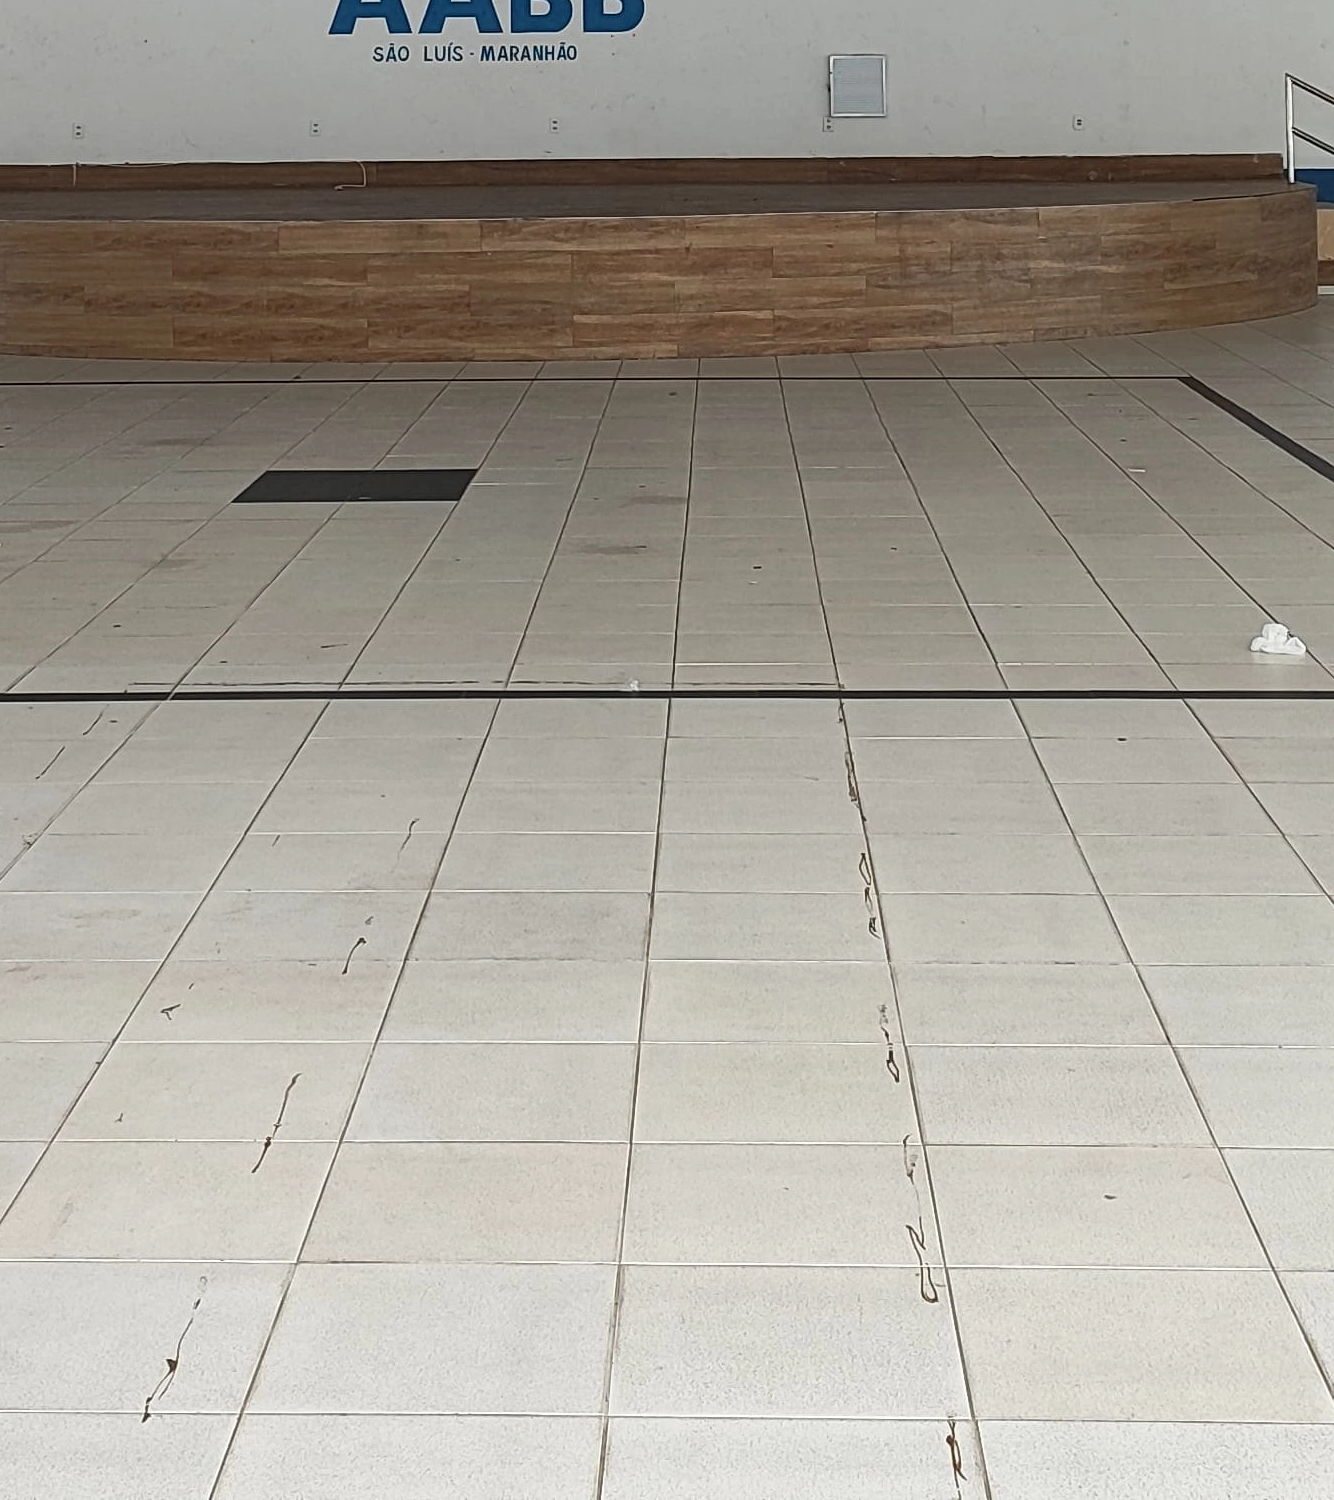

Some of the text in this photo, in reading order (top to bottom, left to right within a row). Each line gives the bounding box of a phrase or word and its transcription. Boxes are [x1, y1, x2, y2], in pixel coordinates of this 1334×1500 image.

[372, 43, 410, 63] SÃO
[423, 42, 464, 62] LUÍS
[479, 42, 578, 62] MARANHÃO
